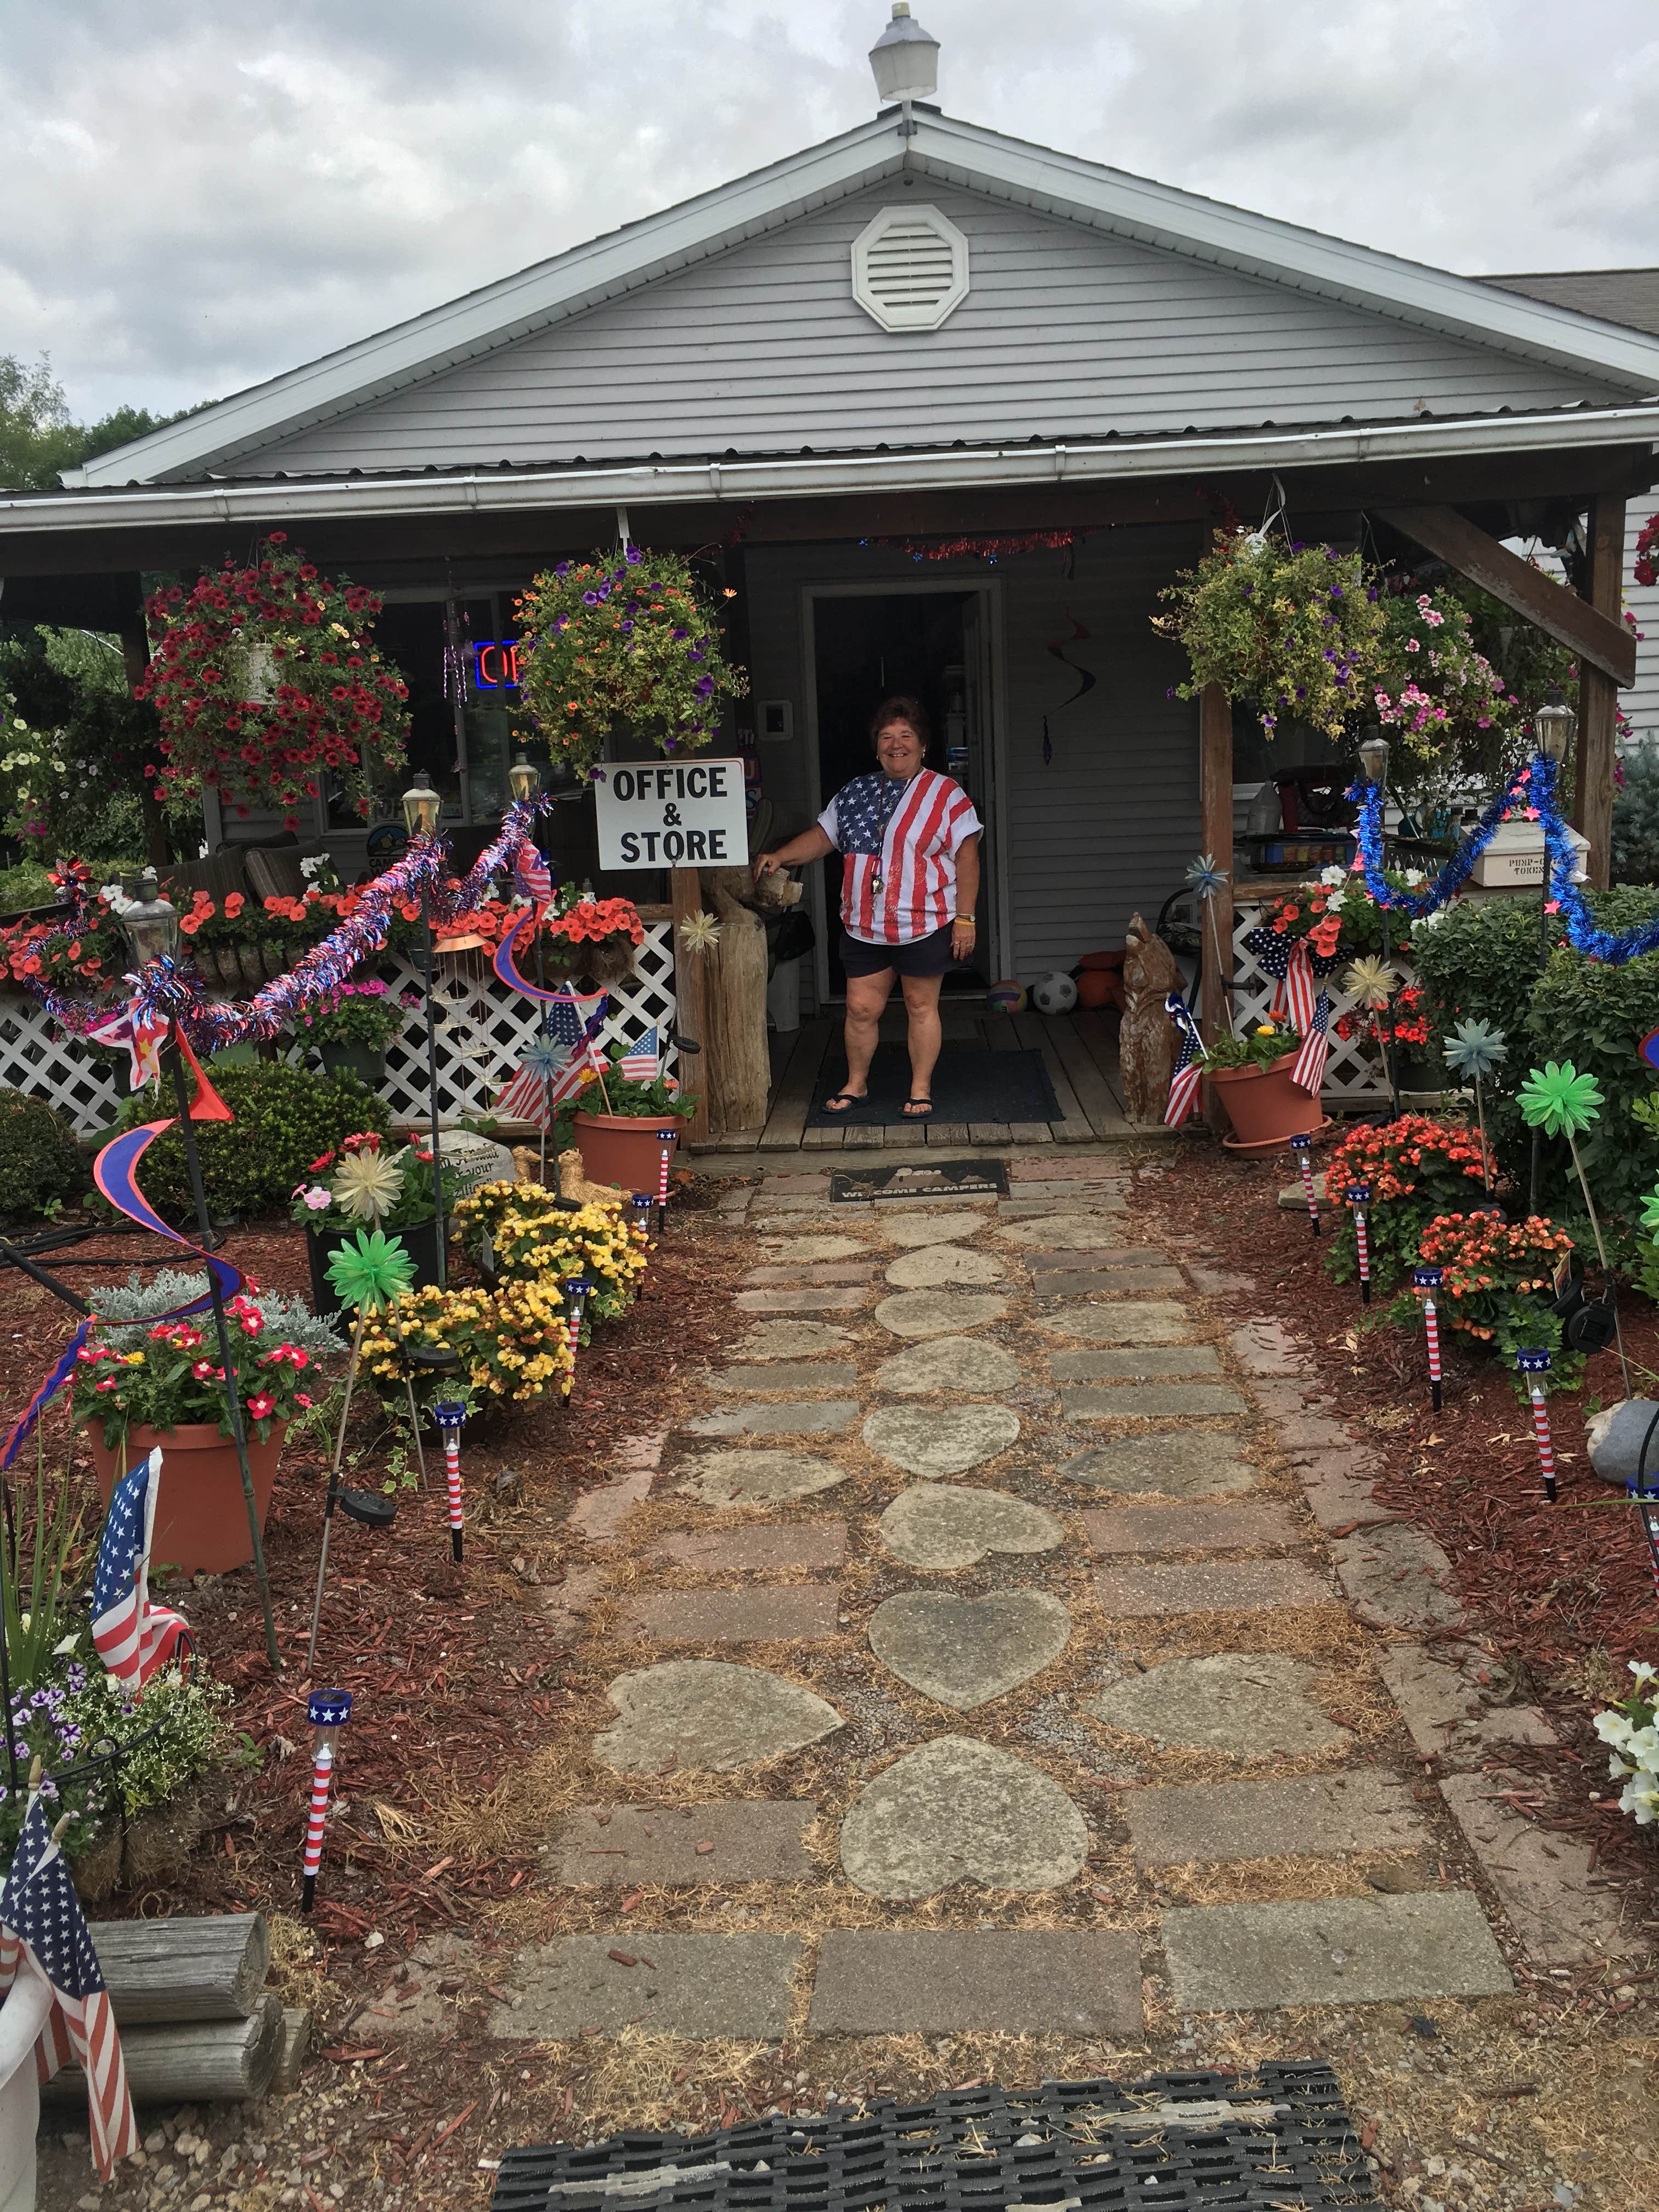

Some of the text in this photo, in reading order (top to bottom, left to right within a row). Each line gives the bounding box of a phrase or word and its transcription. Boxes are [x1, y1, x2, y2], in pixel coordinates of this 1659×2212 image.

[613, 767, 727, 802] OFFICE
[663, 803, 682, 827] &
[620, 830, 727, 863] STORE
[517, 849, 549, 871] SA
[842, 1183, 998, 1198] WECOME CAMPERS
